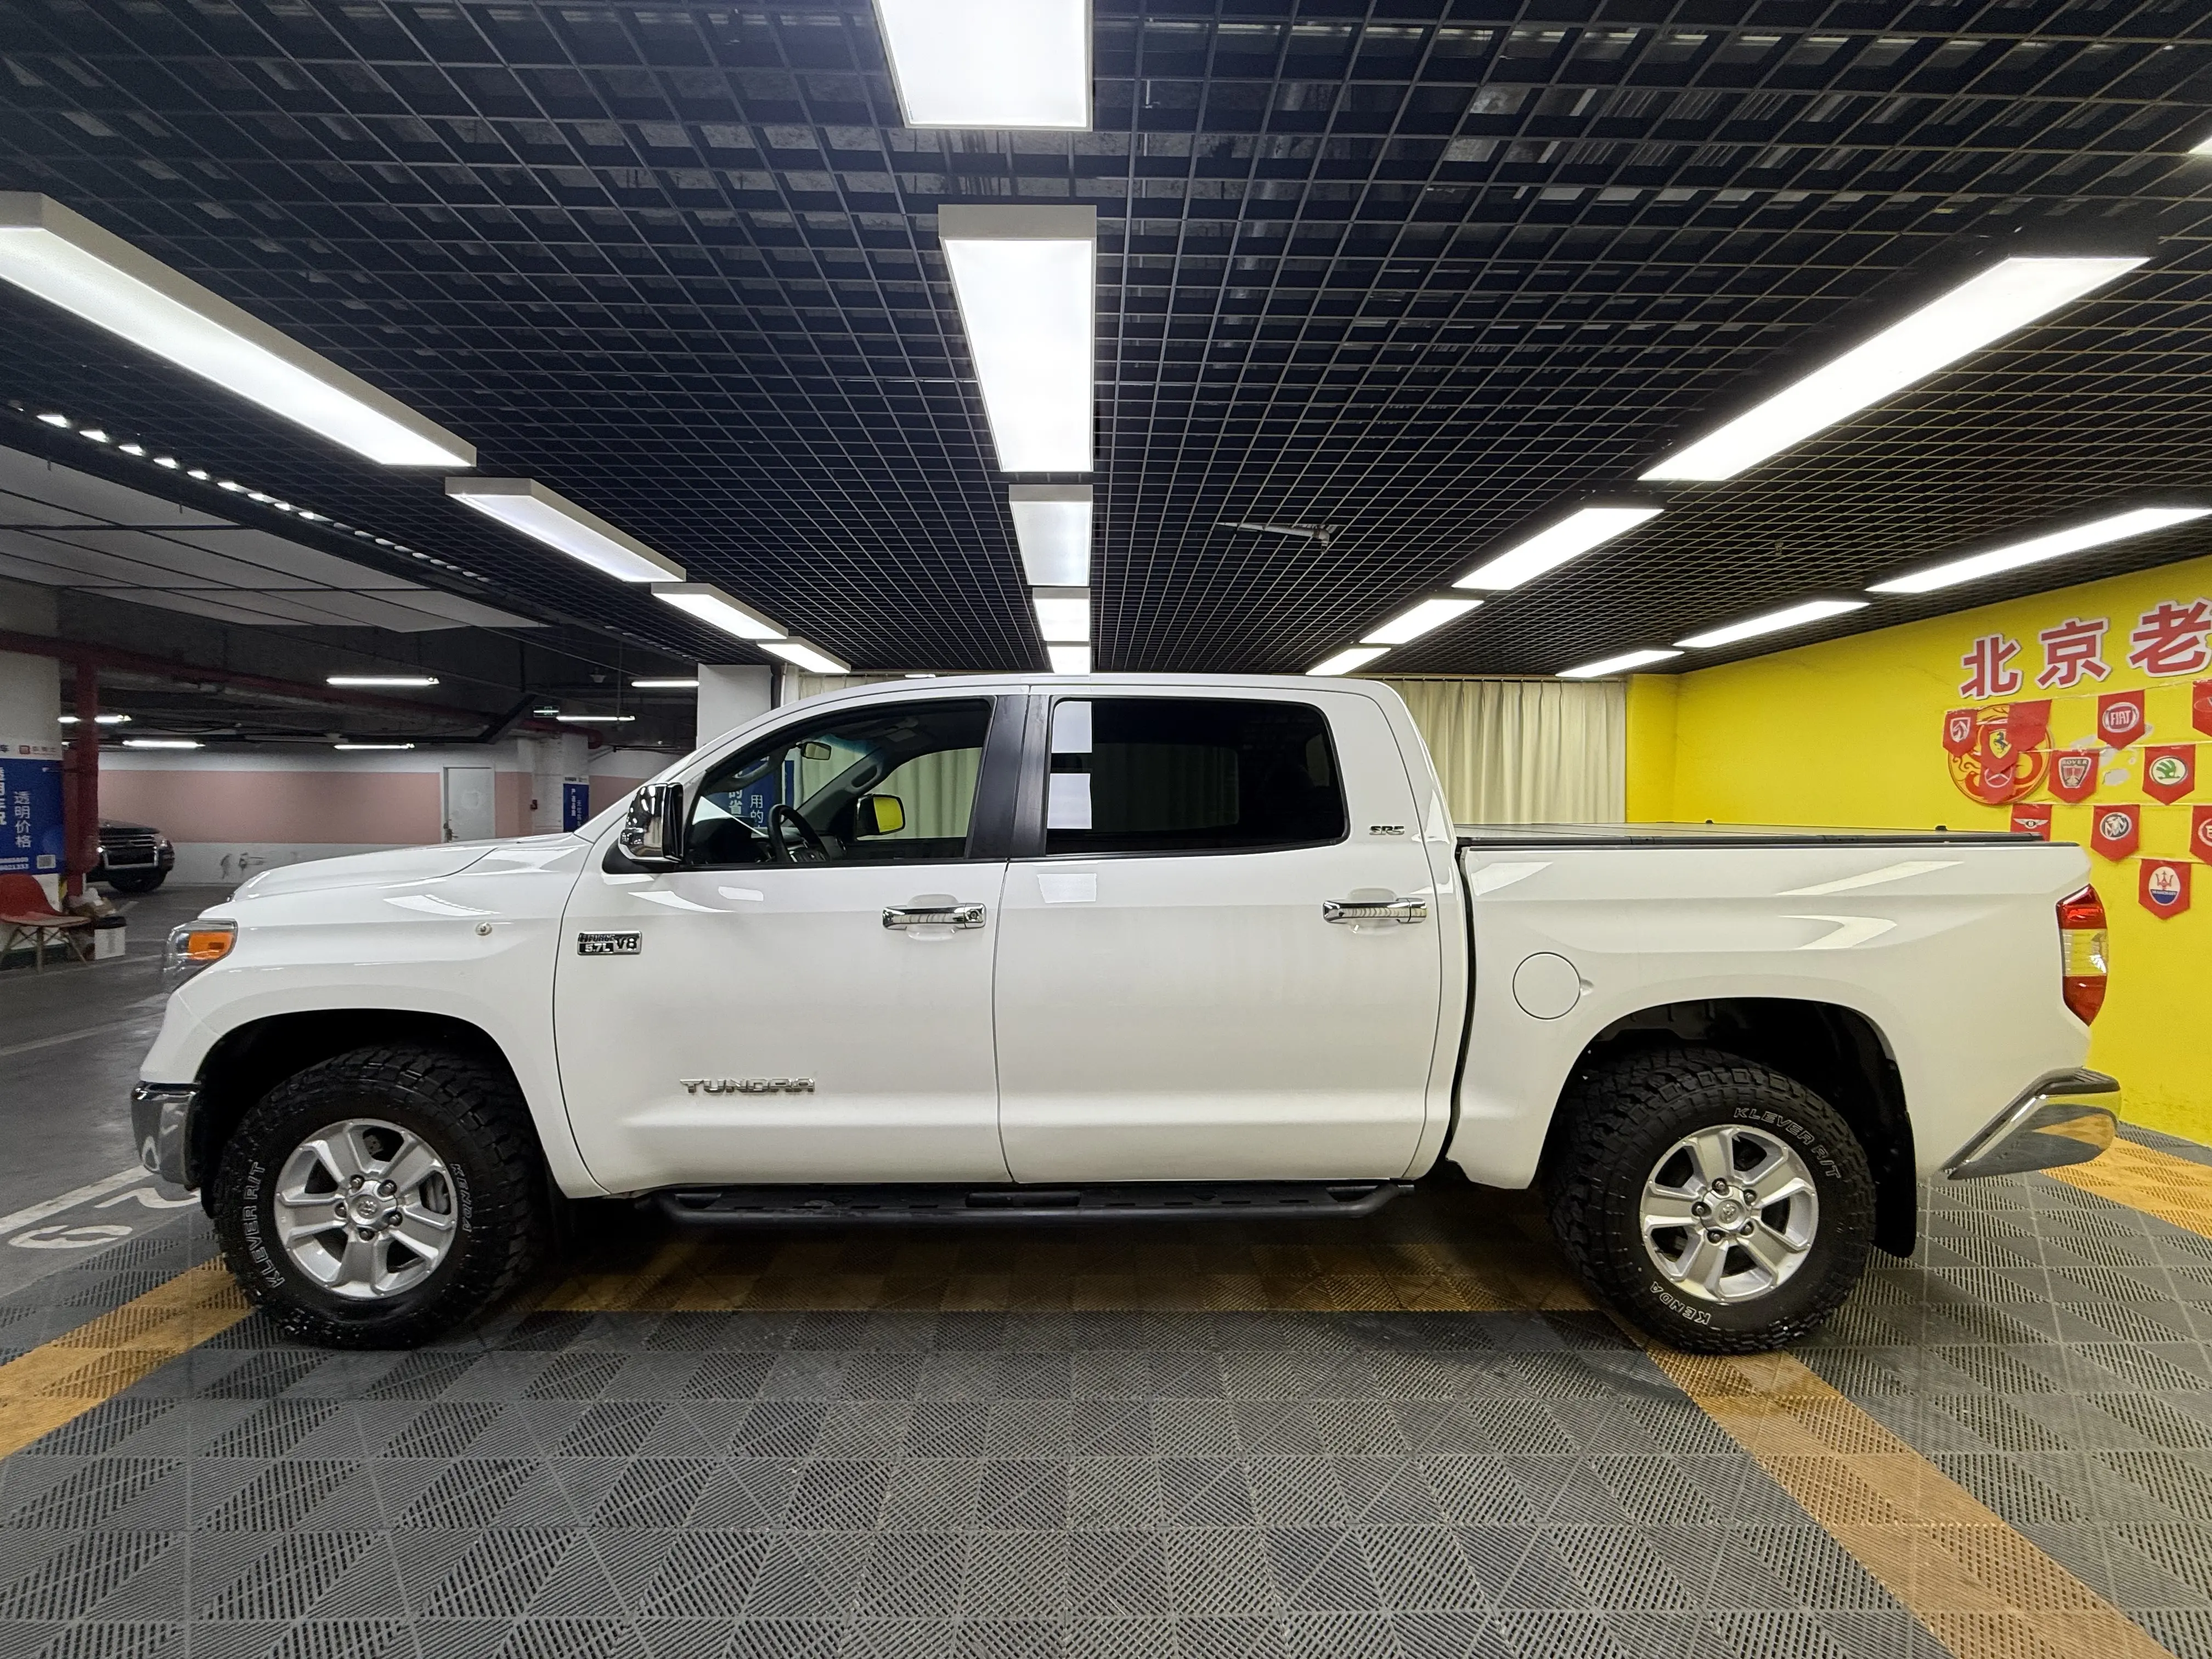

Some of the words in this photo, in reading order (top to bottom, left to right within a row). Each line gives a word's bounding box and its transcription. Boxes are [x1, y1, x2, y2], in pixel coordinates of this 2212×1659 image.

[1960, 600, 2211, 697] 北京老
[2110, 709, 2132, 726] FIAT
[13, 791, 31, 848] 透明价格
[750, 795, 764, 827] 用的
[585, 943, 611, 952] 5.7L
[614, 935, 637, 951] V8
[680, 1079, 815, 1094] TUNDRA
[1733, 1107, 1815, 1146] KLEVER
[1811, 1144, 1842, 1179] R/T
[243, 1161, 266, 1200] R/T
[450, 1163, 472, 1233] KENDA
[241, 1205, 285, 1289] KLEVER
[1650, 1281, 1711, 1325] KENDA
